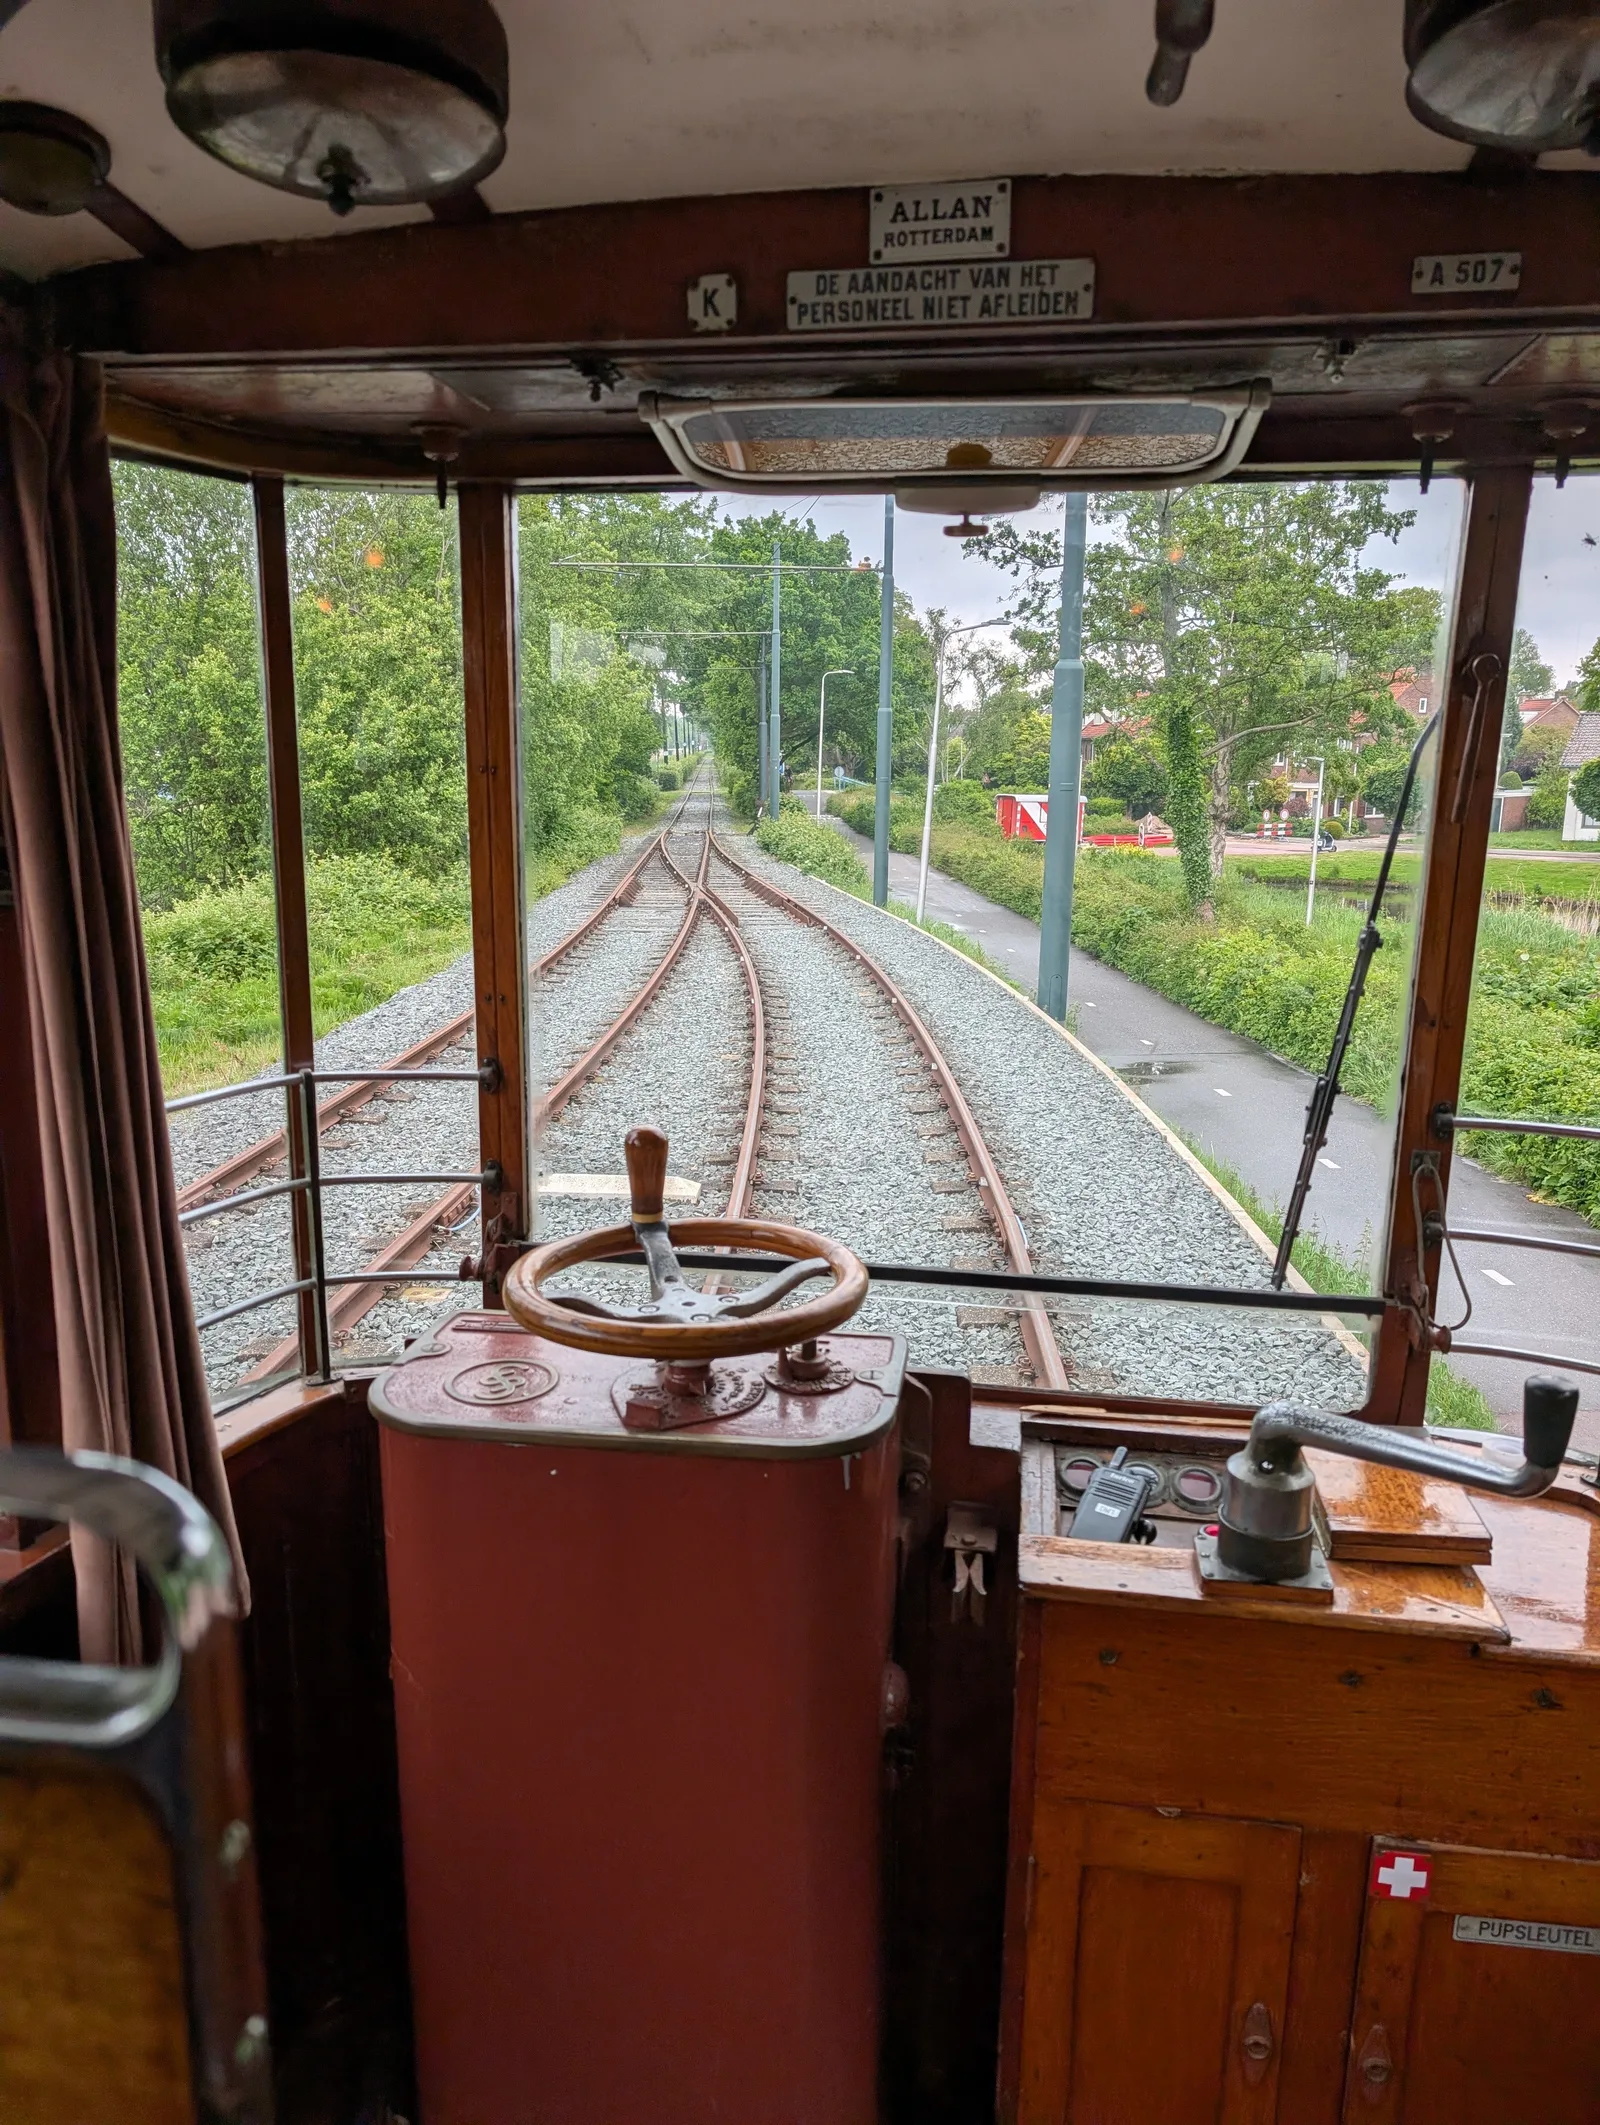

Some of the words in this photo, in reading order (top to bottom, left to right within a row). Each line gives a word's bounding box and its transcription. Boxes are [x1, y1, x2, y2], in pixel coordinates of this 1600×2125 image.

[889, 195, 993, 224] ALLAN
[883, 226, 994, 249] ROTTERDAM
[815, 273, 840, 297] DE
[847, 268, 961, 295] AANDACHT
[968, 266, 1011, 289] VAN
[1020, 263, 1060, 287] HET
[1429, 261, 1444, 286] A
[1454, 257, 1505, 285] 507
[703, 287, 721, 318] K
[797, 297, 915, 325] PERSONEEL
[922, 294, 971, 320] NIET
[978, 290, 1080, 318] AFLEIDEN
